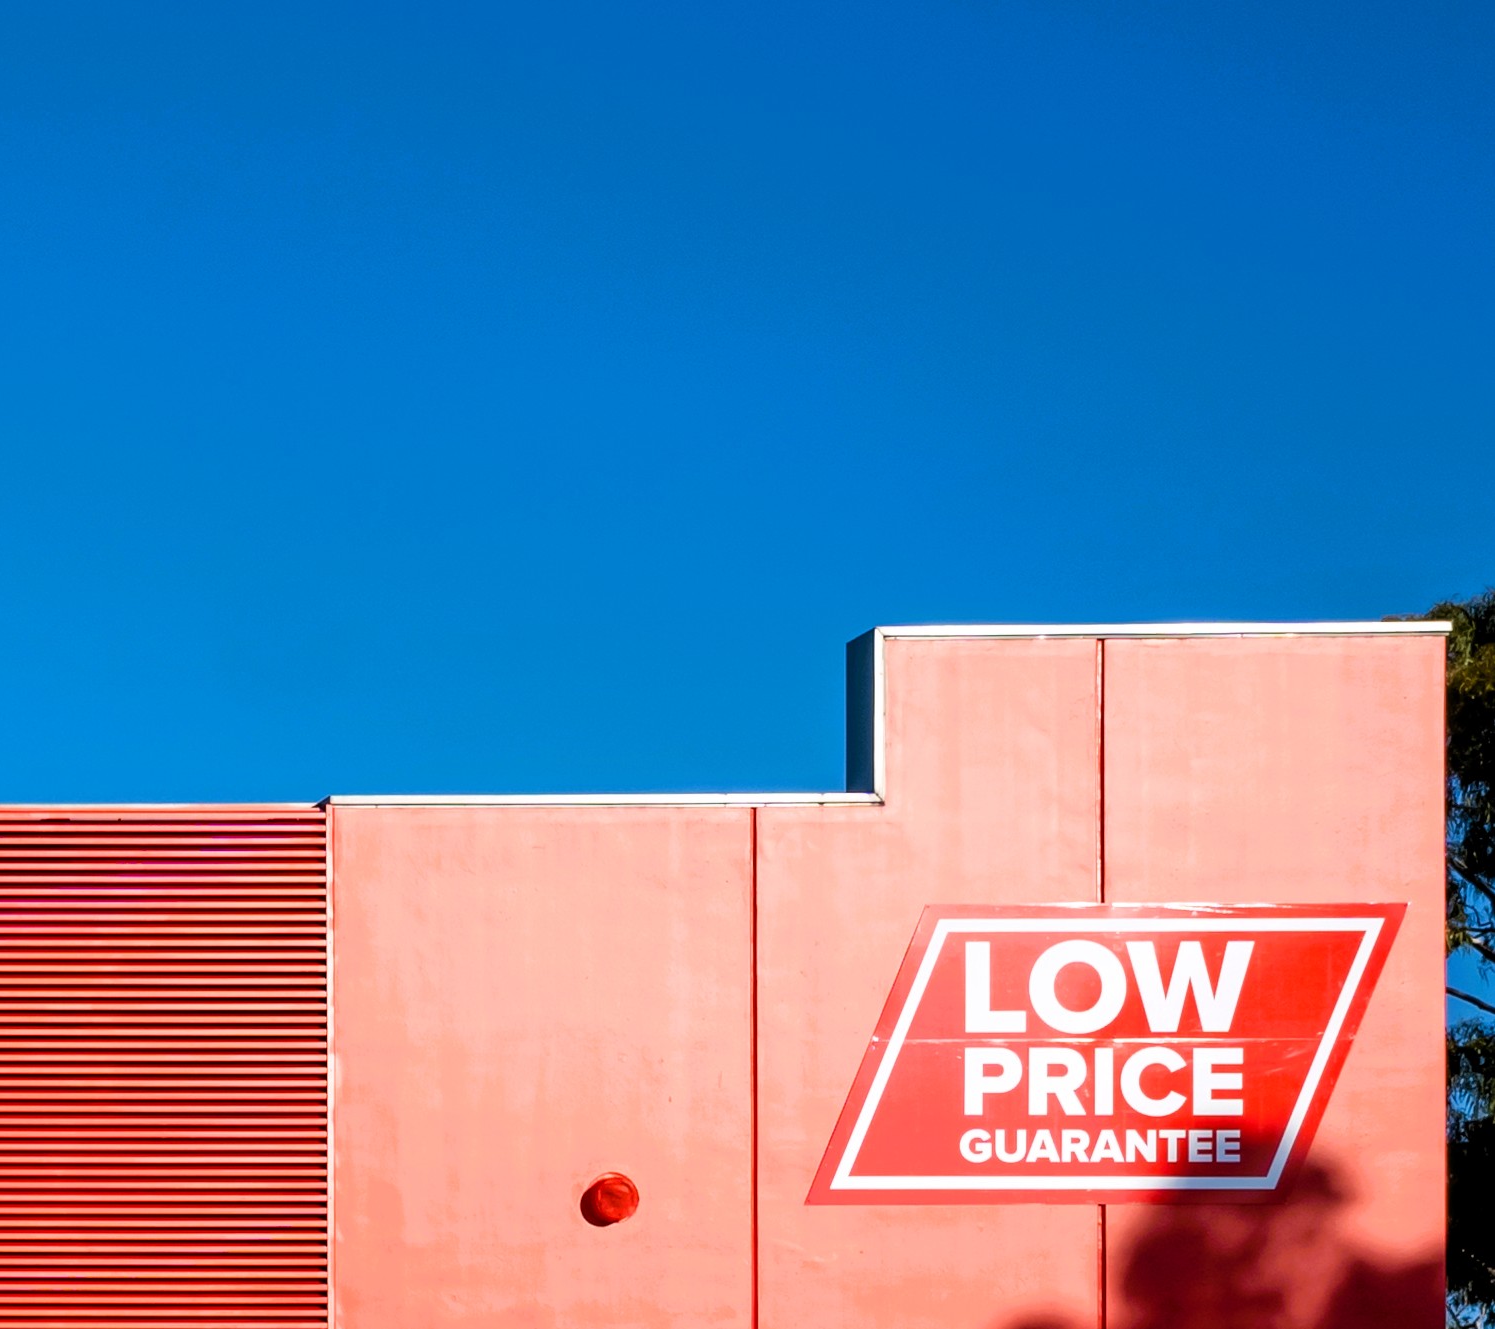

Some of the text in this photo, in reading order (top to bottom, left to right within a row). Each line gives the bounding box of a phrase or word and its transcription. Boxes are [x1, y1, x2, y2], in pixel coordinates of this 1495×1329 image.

[963, 938, 1256, 1035] LOW
[963, 1045, 1245, 1118] PRICE
[958, 1128, 1242, 1164] GUARANTEE
